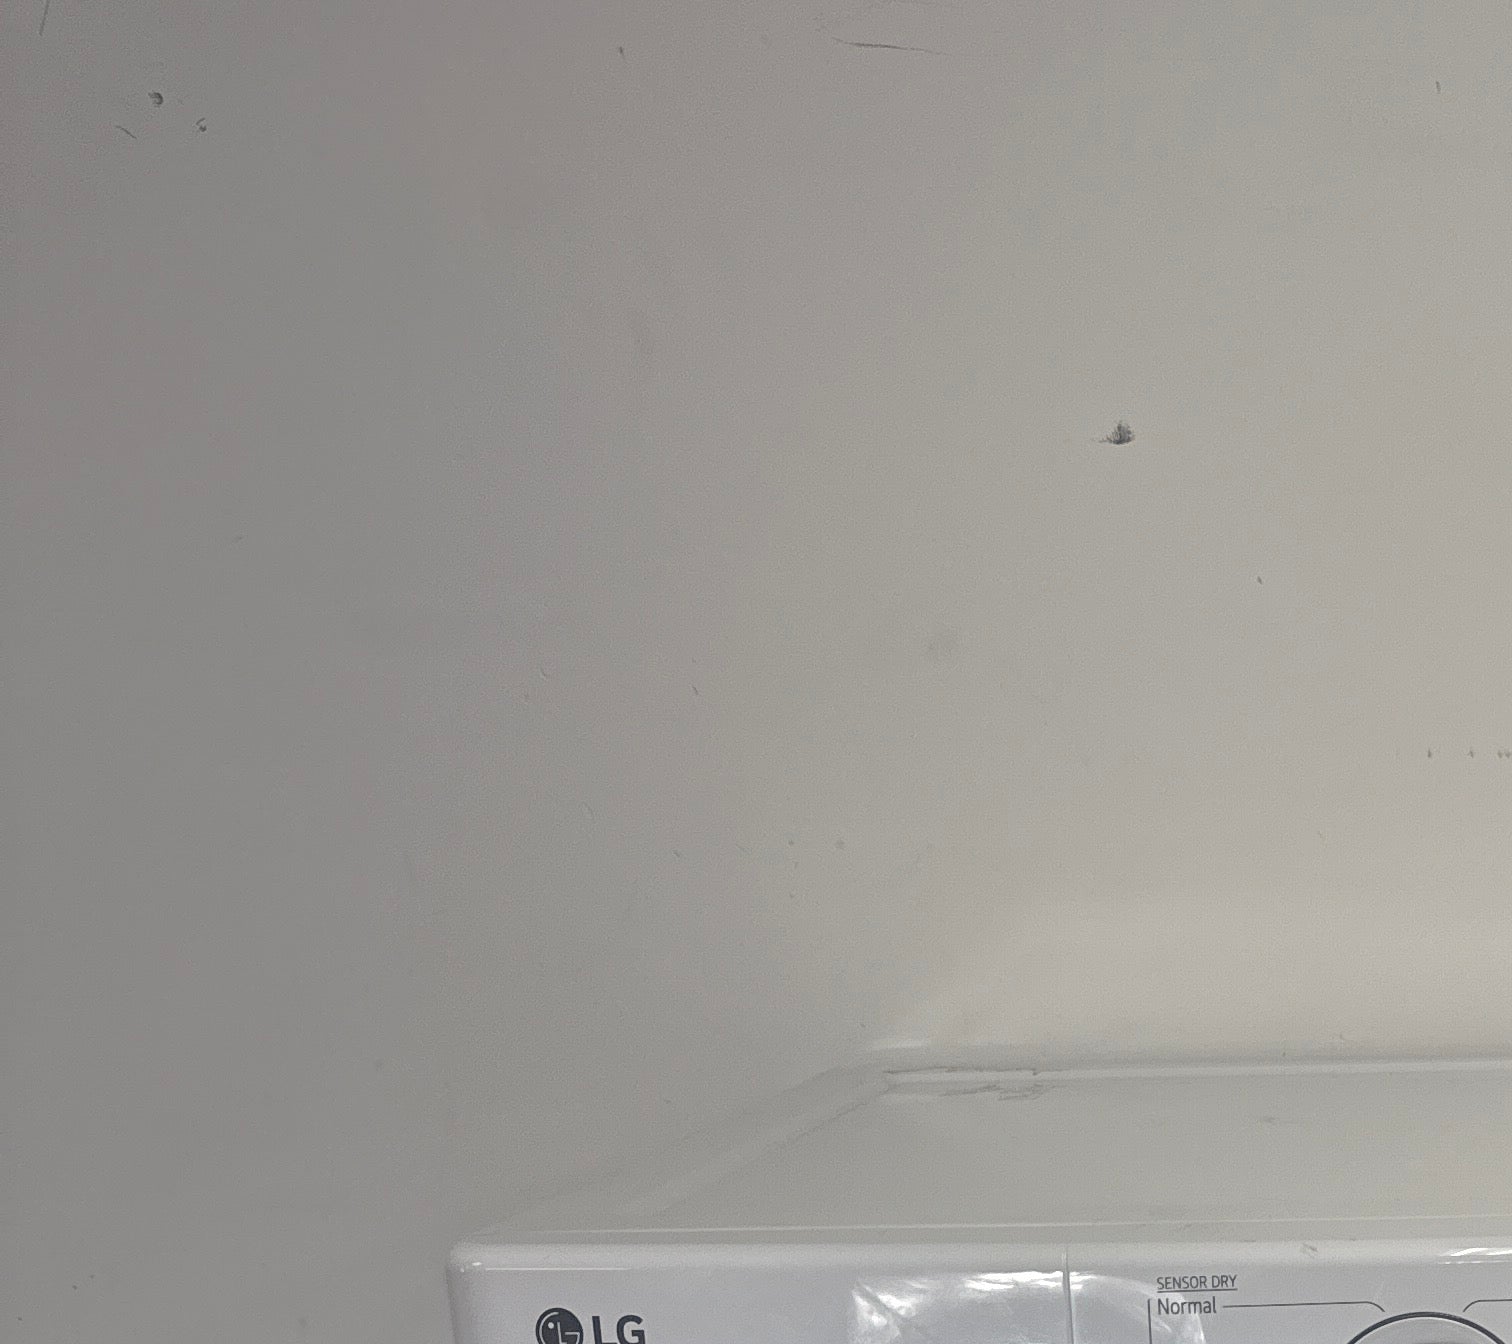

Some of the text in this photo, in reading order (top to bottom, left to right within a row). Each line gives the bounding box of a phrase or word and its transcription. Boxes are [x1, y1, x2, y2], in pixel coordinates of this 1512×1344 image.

[1156, 1274, 1238, 1290] SENSOR DRY
[1157, 1295, 1217, 1315] Normal
